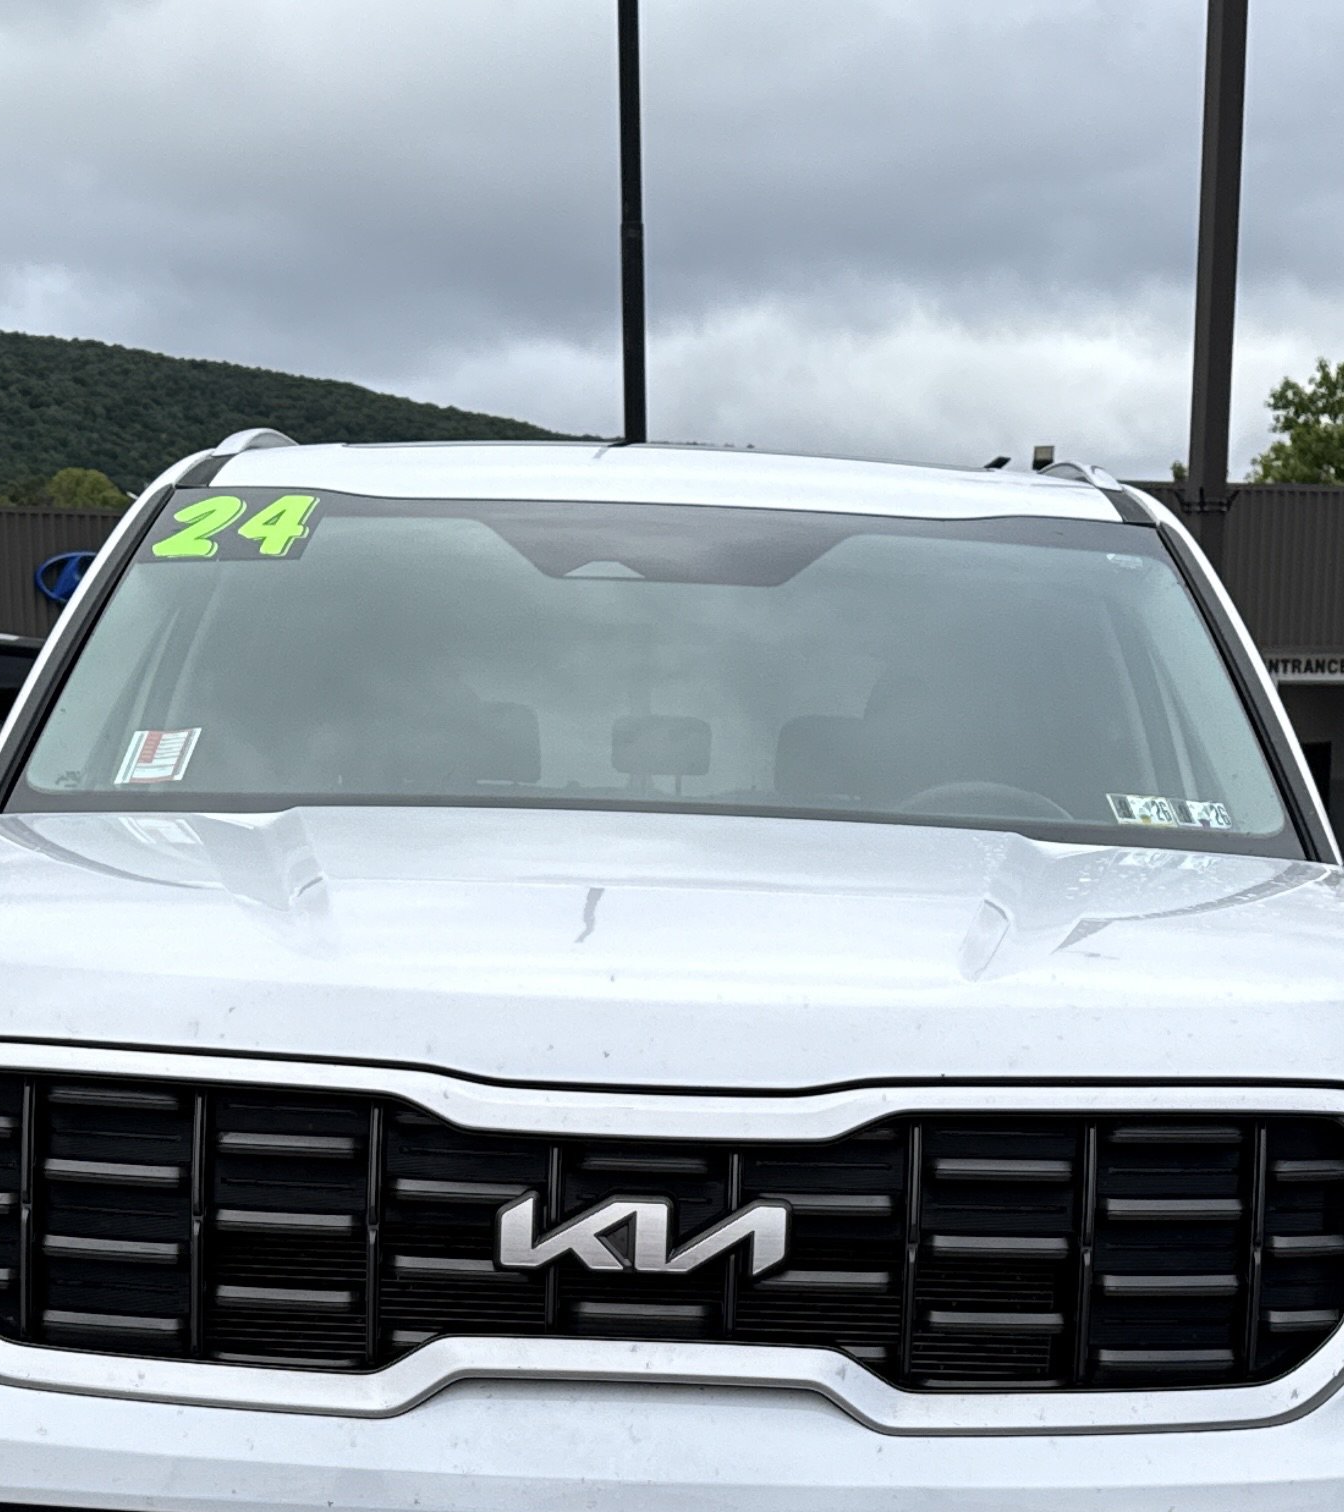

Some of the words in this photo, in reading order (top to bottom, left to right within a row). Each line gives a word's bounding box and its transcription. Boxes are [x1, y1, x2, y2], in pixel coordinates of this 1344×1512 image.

[151, 494, 321, 558] 24
[1149, 799, 1173, 823] 26
[1209, 804, 1233, 827] 26
[499, 1196, 788, 1276] KIA
